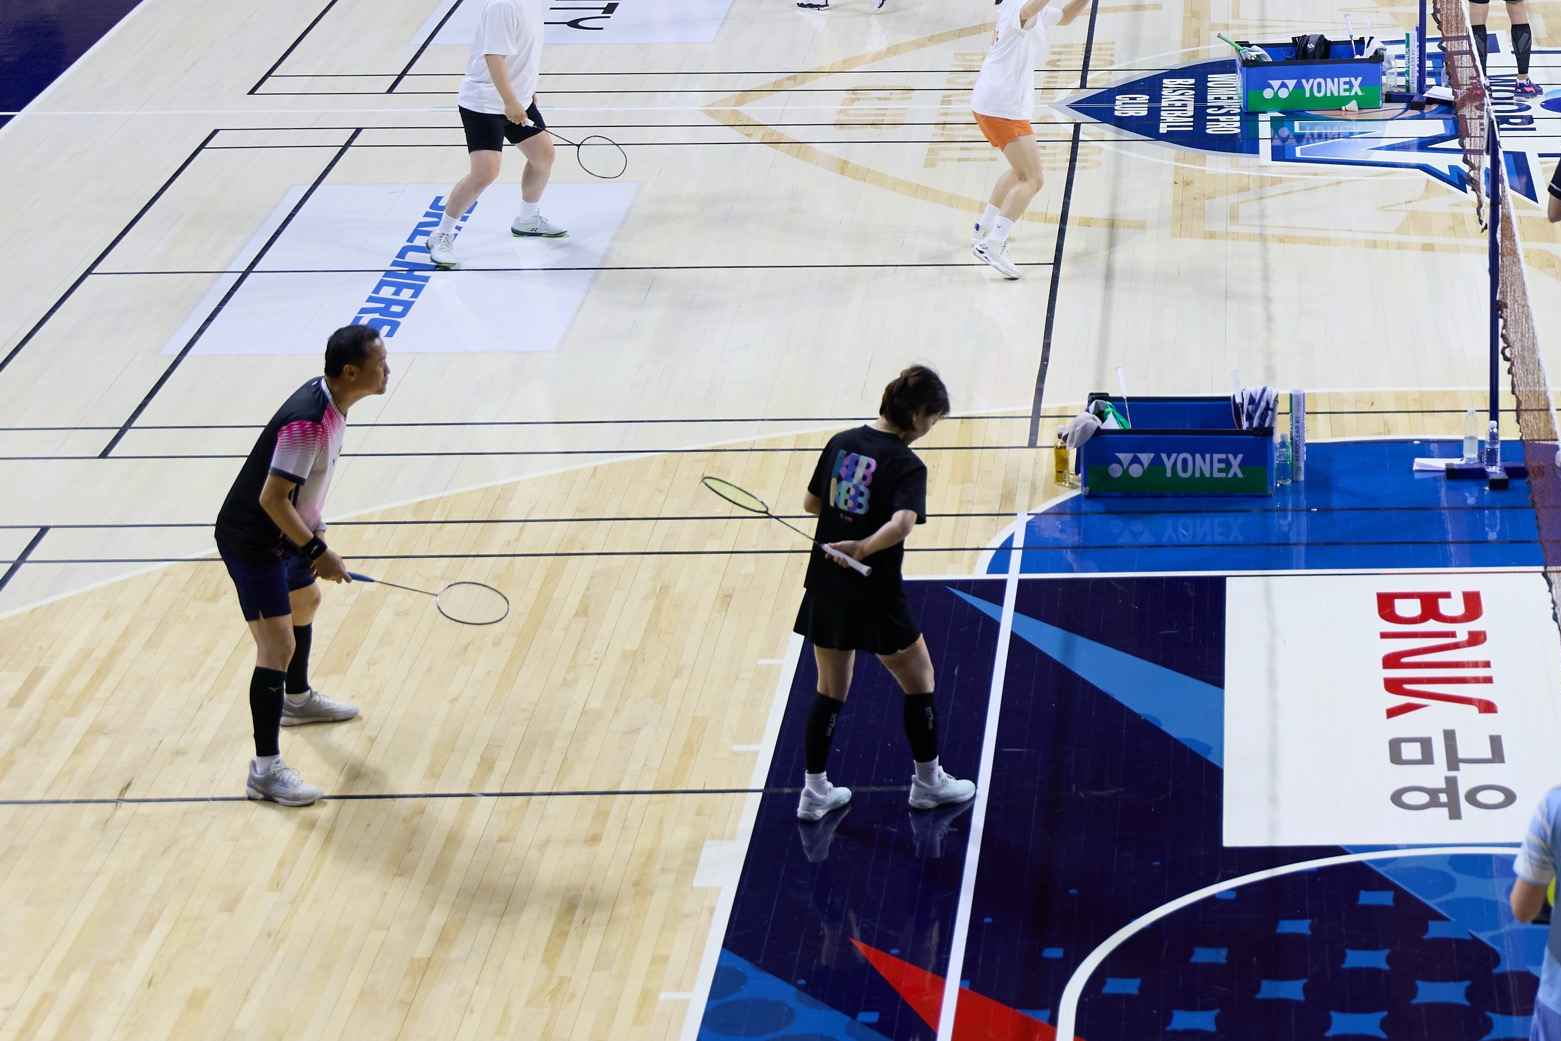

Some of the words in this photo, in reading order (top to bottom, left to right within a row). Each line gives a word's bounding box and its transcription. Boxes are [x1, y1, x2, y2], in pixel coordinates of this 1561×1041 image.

[1301, 76, 1364, 98] YONEX
[1114, 94, 1150, 118] CLUB
[1159, 78, 1196, 134] BASKETBALL
[1205, 115, 1242, 135] PRO
[1160, 452, 1244, 479] YONEX
[1375, 590, 1499, 720] BNK
[1388, 728, 1518, 821] 금융
